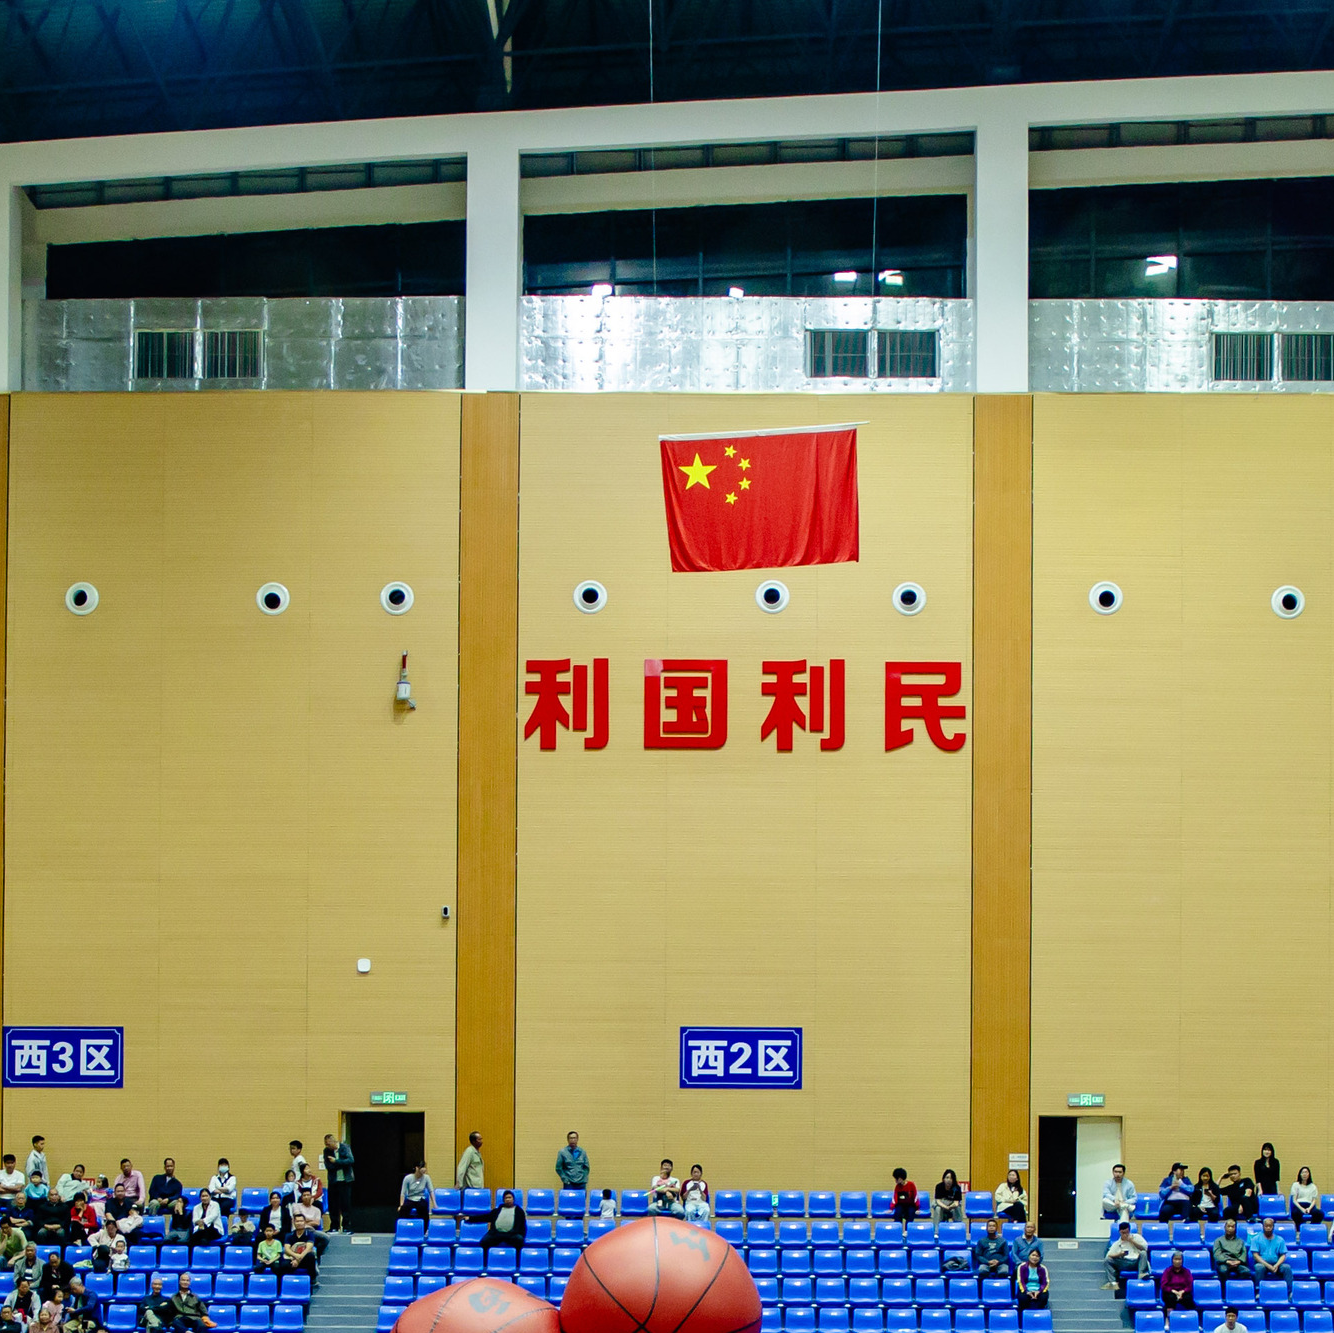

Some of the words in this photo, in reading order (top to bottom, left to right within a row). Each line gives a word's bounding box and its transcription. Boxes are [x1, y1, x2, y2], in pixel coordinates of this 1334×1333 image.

[524, 657, 967, 752] 利国利民
[11, 1038, 115, 1076] 西3区
[688, 1039, 793, 1077] 西2区
